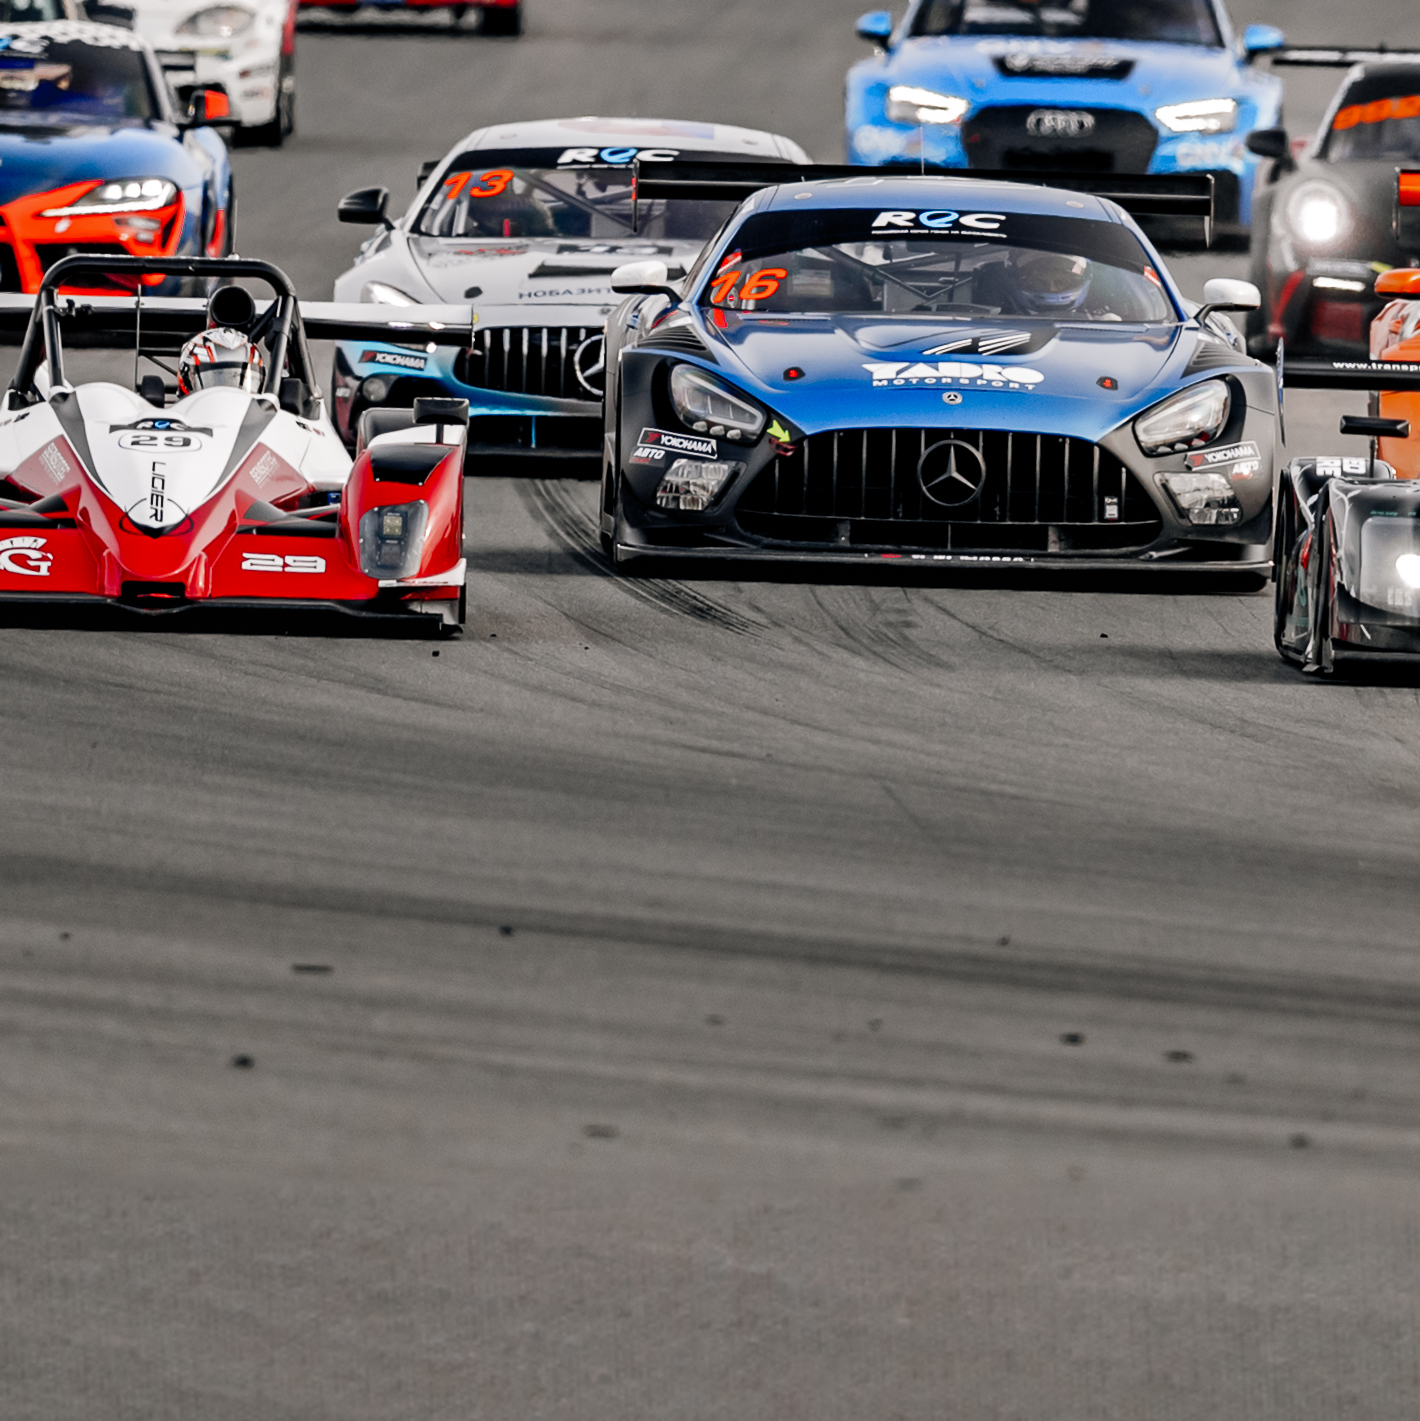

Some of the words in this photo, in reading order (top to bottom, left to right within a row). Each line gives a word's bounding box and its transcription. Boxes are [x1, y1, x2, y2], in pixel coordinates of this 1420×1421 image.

[444, 169, 515, 200] 13
[711, 268, 788, 303] 16
[872, 378, 1037, 391] MOTORSPORT
[130, 435, 192, 447] 29
[660, 434, 713, 454] YOKOHAMA
[1204, 446, 1255, 463] YOKOHAMA
[241, 552, 326, 574] 29
